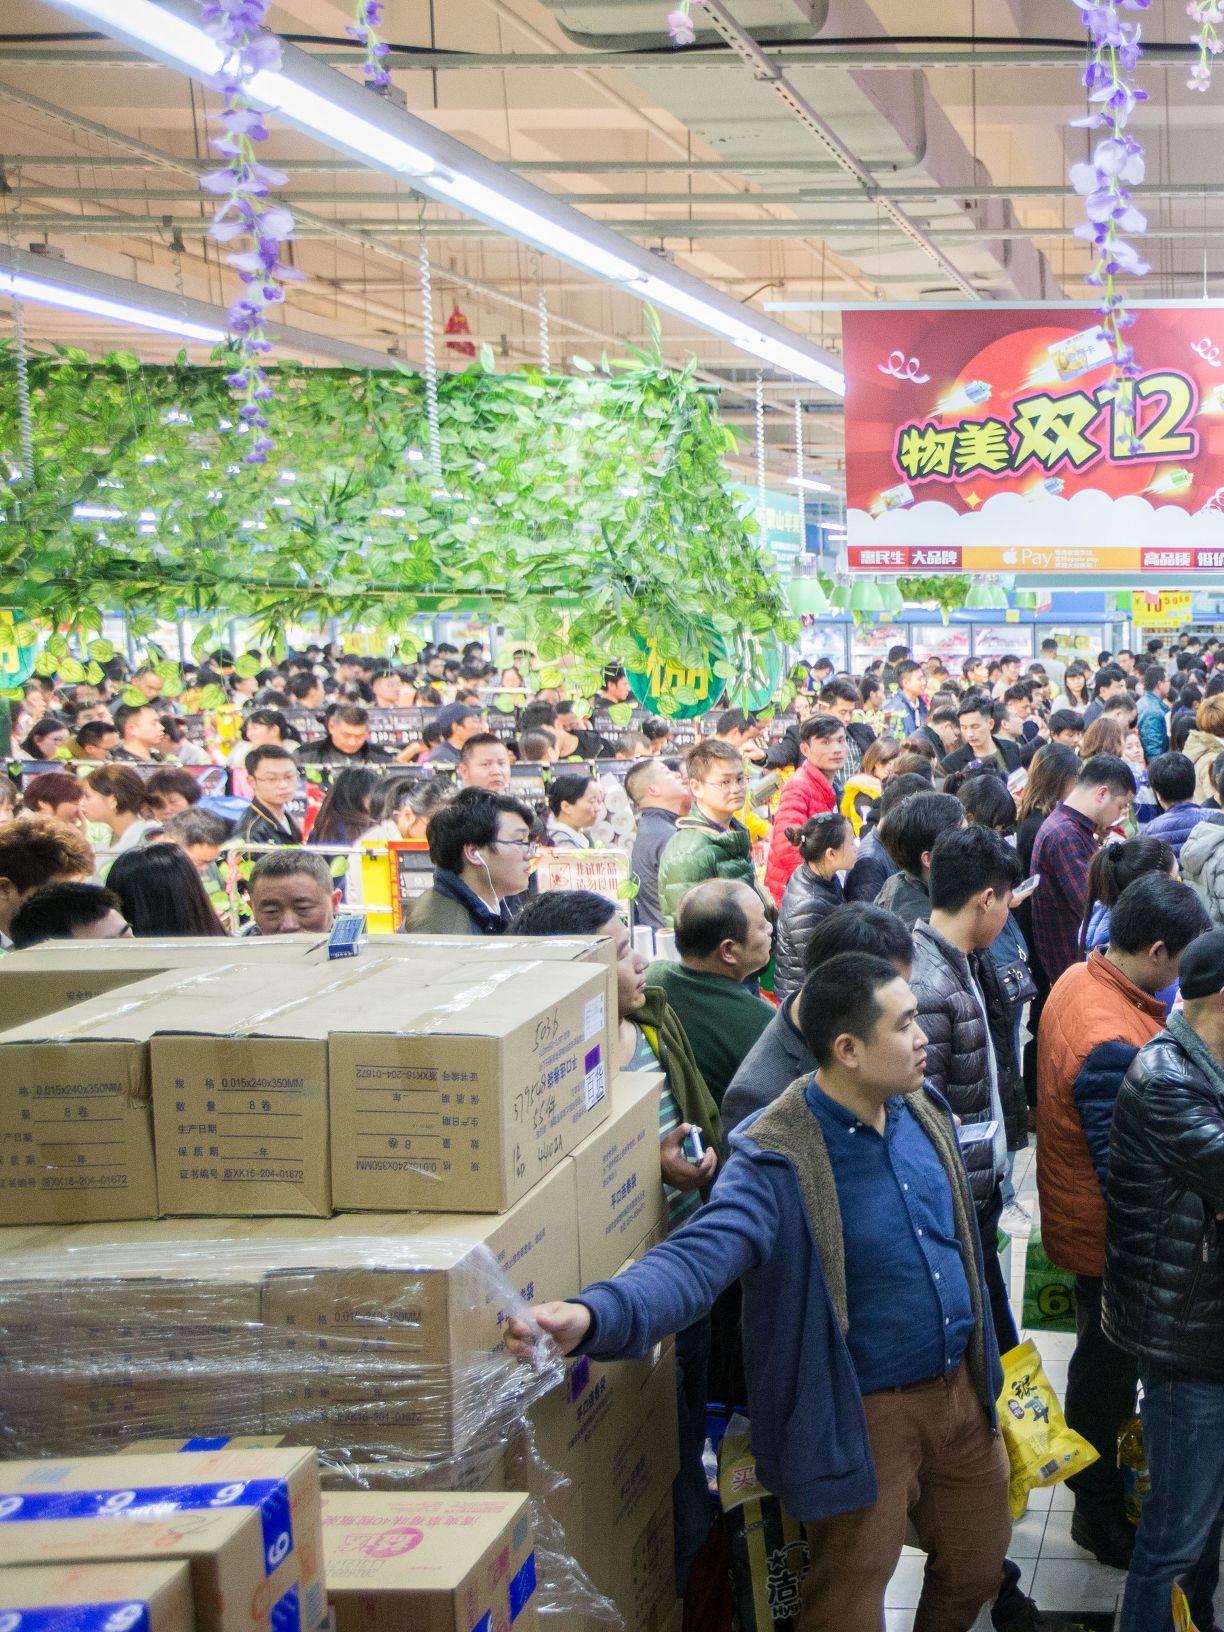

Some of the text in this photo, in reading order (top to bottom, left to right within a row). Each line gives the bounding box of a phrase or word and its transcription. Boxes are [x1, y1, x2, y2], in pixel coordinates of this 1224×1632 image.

[902, 376, 1192, 477] 物美双12
[860, 551, 905, 565] 惠民生
[911, 551, 957, 565] 大品牌
[1021, 549, 1053, 568] Pay
[1144, 552, 1190, 566] 高品质
[442, 1116, 479, 1127] 生产日期
[178, 1124, 217, 1135] 生产日期
[180, 1169, 218, 1180] 证书编号
